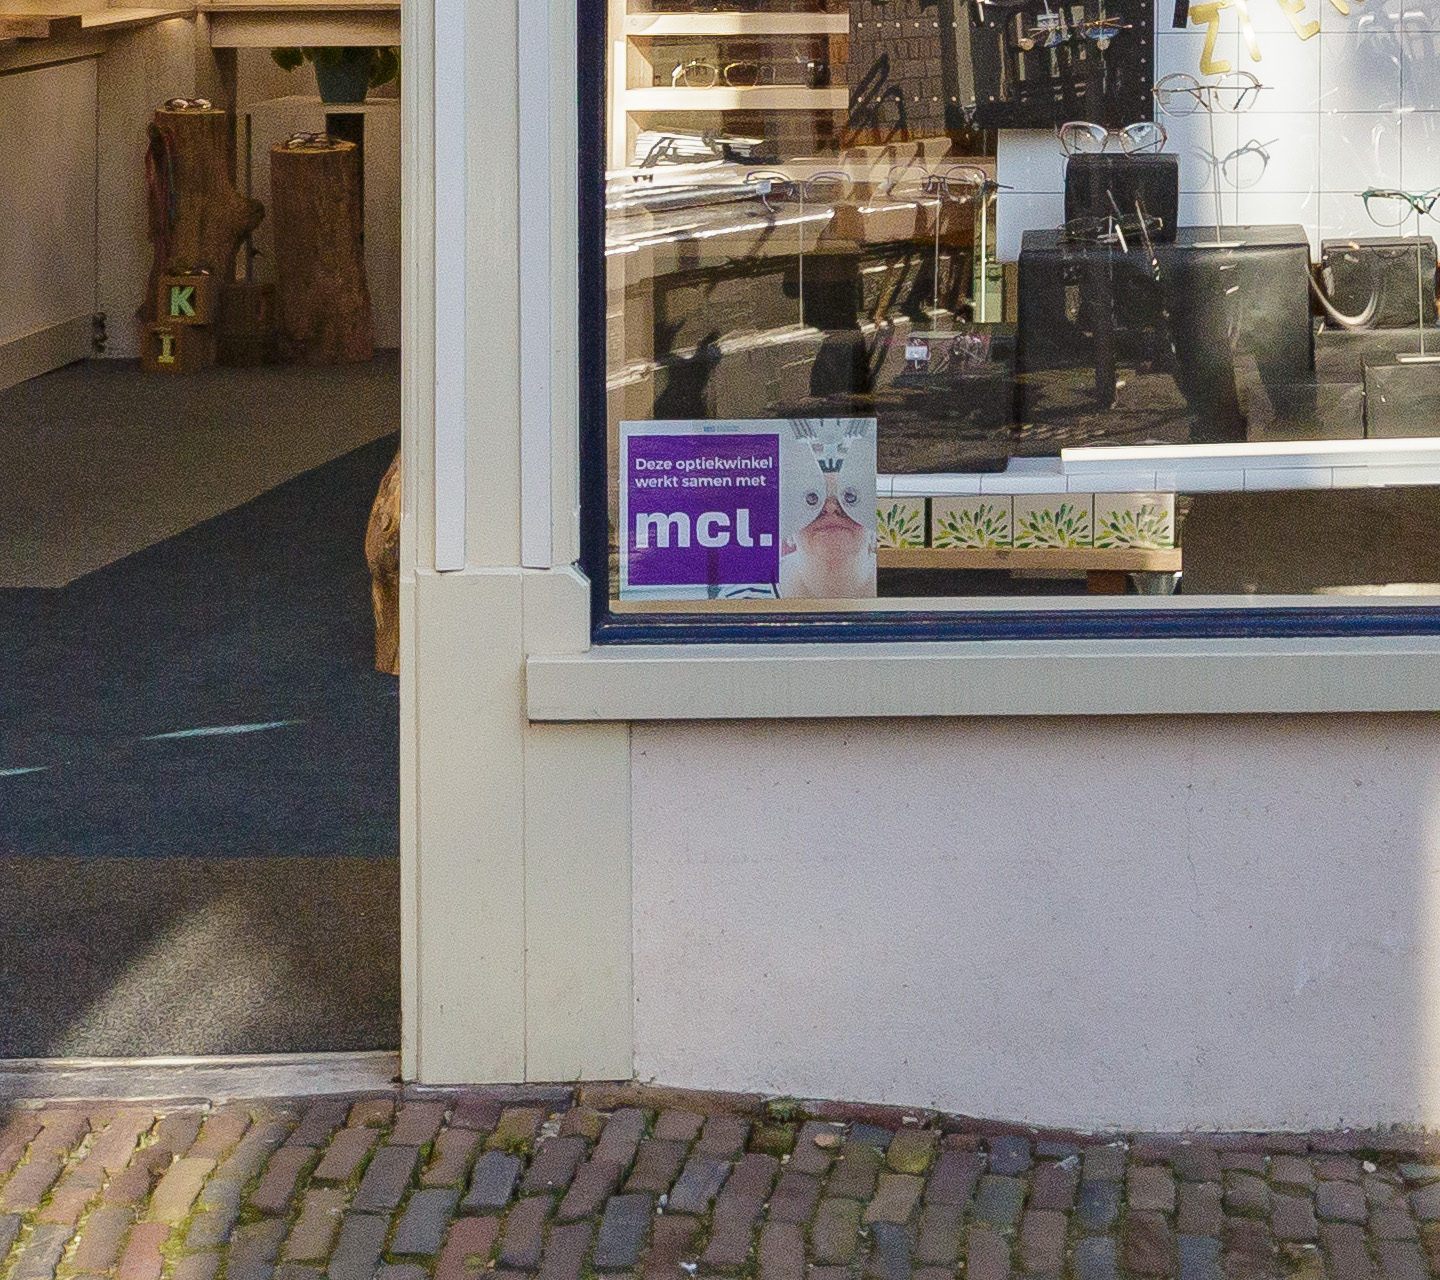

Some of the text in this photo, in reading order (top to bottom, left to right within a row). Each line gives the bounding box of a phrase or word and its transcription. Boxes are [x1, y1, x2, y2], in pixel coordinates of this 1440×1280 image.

[635, 456, 773, 472] Deze optiekwinkel
[635, 475, 767, 488] werkt samen met
[636, 508, 773, 548] mcl.
